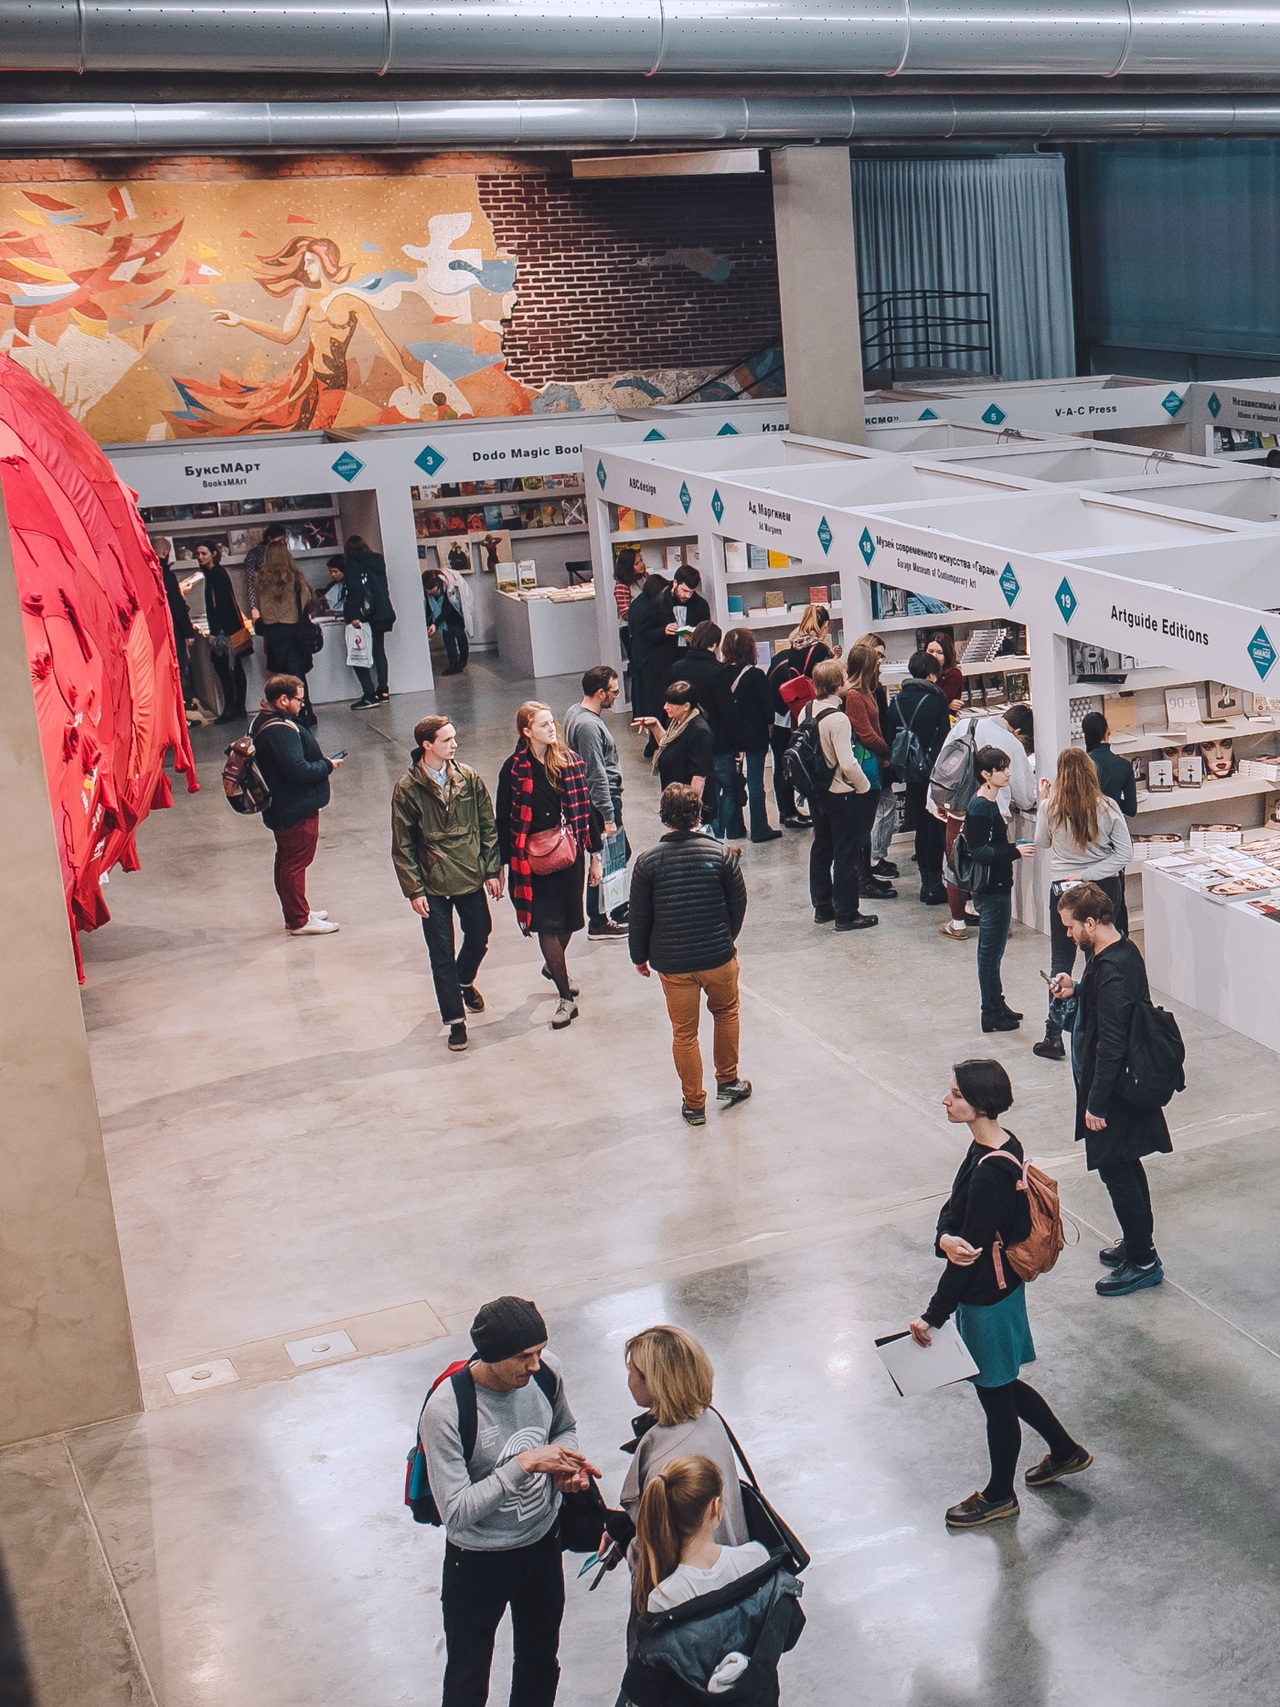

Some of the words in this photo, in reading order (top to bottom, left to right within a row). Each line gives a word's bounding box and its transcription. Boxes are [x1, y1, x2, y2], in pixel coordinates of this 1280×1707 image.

[1055, 406, 1085, 417] V-A-C
[1088, 404, 1117, 415] Press
[1232, 396, 1277, 411] Независимый
[991, 412, 997, 421] 5
[426, 456, 434, 466] 3
[473, 451, 506, 462] Dodo
[511, 446, 550, 459] Magic
[185, 462, 261, 477] БуксМАрт
[202, 478, 247, 488] BooksMArt
[629, 477, 657, 496] ABCdesign
[714, 501, 721, 513] 17
[748, 500, 757, 515] Ад
[757, 502, 792, 522] Маргинем
[862, 541, 871, 553] 18
[876, 535, 895, 549] Музей
[895, 541, 938, 561] современного
[939, 554, 971, 570] искусства
[972, 560, 999, 577] «Гараж»
[897, 557, 911, 572] Garage
[912, 563, 931, 577] Museum
[931, 568, 937, 577] of
[937, 568, 968, 588] Contemporary
[969, 577, 977, 589] Art
[1060, 593, 1072, 609] 19
[1110, 605, 1158, 632] Artguide
[1161, 618, 1209, 646] Editions
